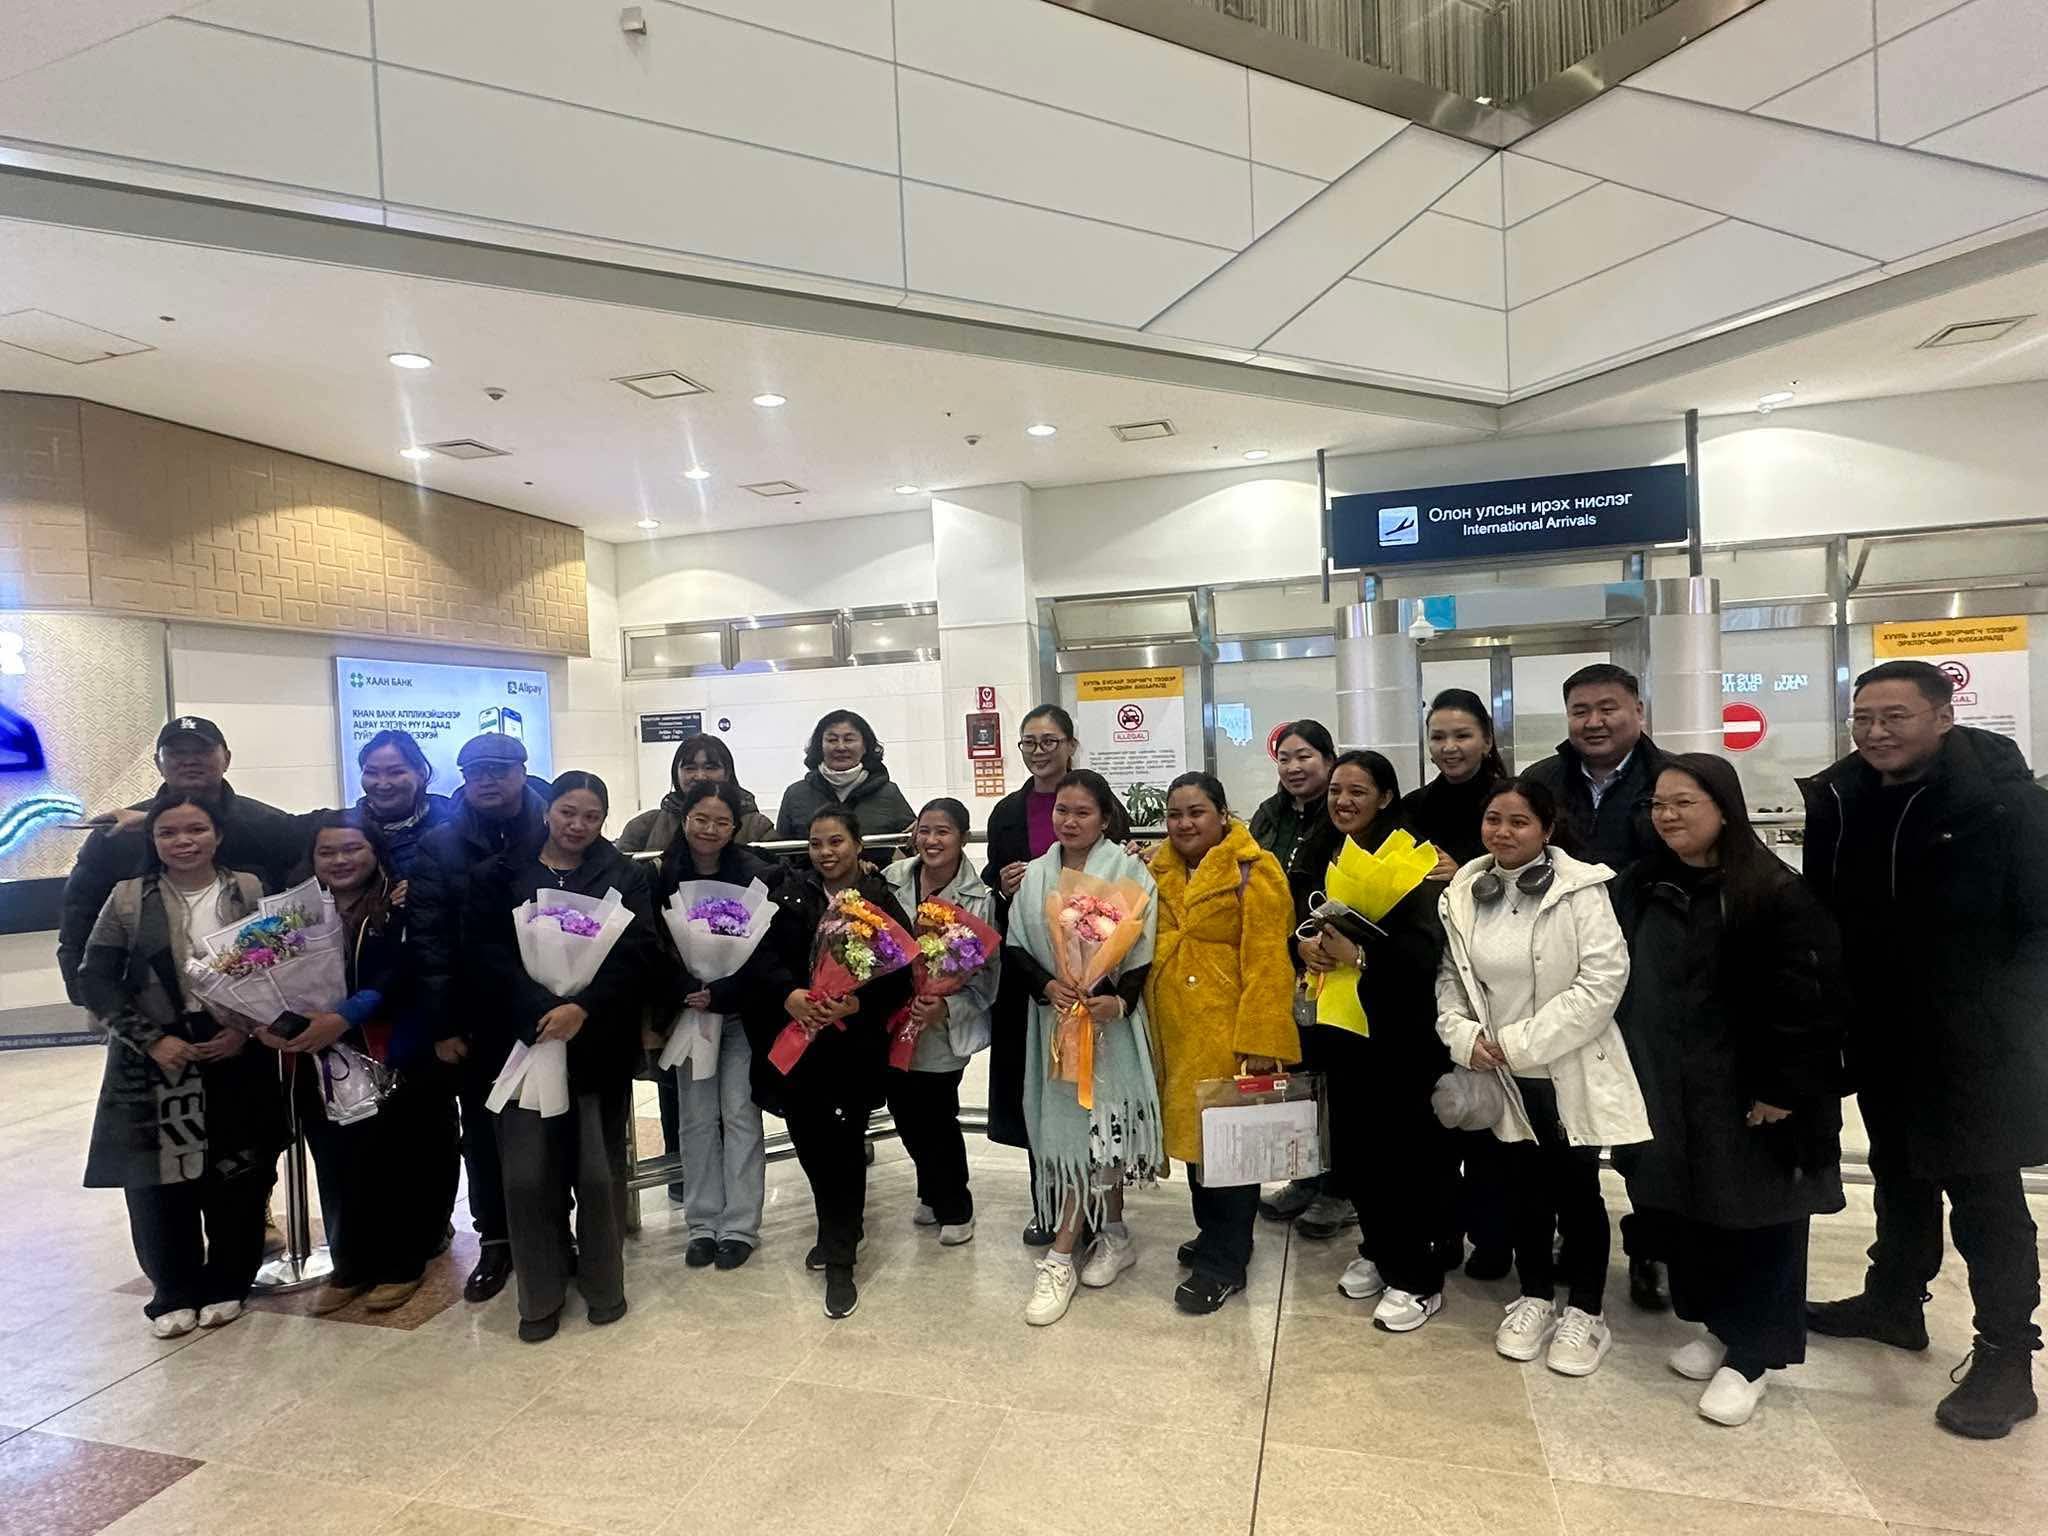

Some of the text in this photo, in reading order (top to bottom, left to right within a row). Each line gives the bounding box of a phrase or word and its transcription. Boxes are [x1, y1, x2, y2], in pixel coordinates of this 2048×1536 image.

[1429, 493, 1633, 522] Олон улсын ирэх нислэг
[1463, 513, 1597, 536] International Arrivals
[366, 676, 413, 687] ХААН БАНК
[518, 682, 542, 695] Alipay
[353, 709, 375, 718] KHAN
[376, 710, 396, 718] BANK
